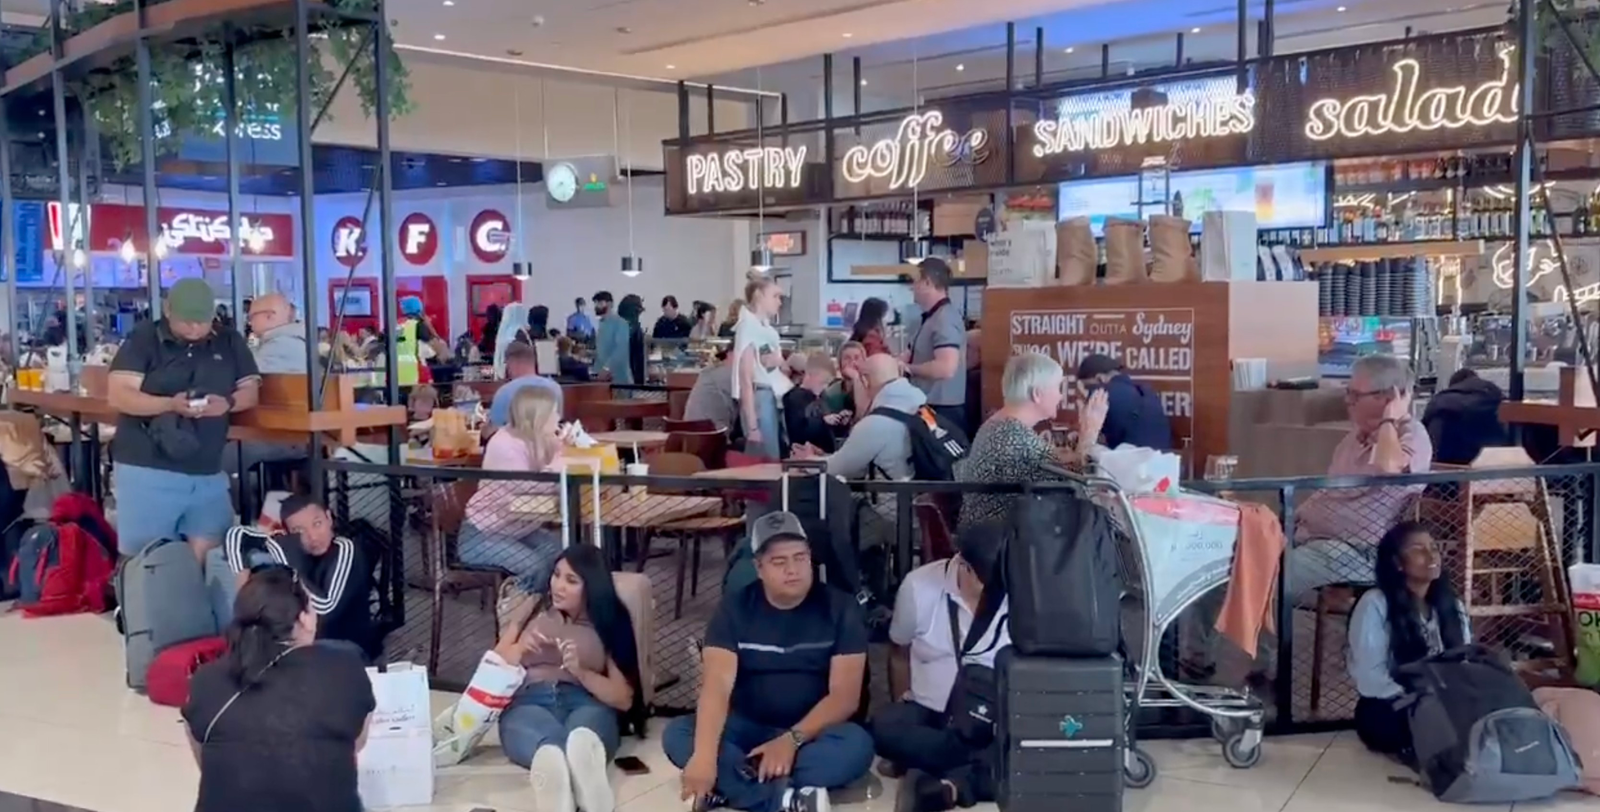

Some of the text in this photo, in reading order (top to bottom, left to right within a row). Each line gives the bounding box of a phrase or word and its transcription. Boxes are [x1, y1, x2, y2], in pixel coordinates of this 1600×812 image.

[1305, 45, 1520, 140] salad
[1033, 91, 1256, 158] SANDWICHES
[687, 146, 806, 193] PASTRY
[843, 110, 989, 189] coffee
[405, 223, 430, 254] F
[1012, 312, 1192, 344] STRAIGHT OUTTA Sydney
[1126, 347, 1191, 369] CALLED
